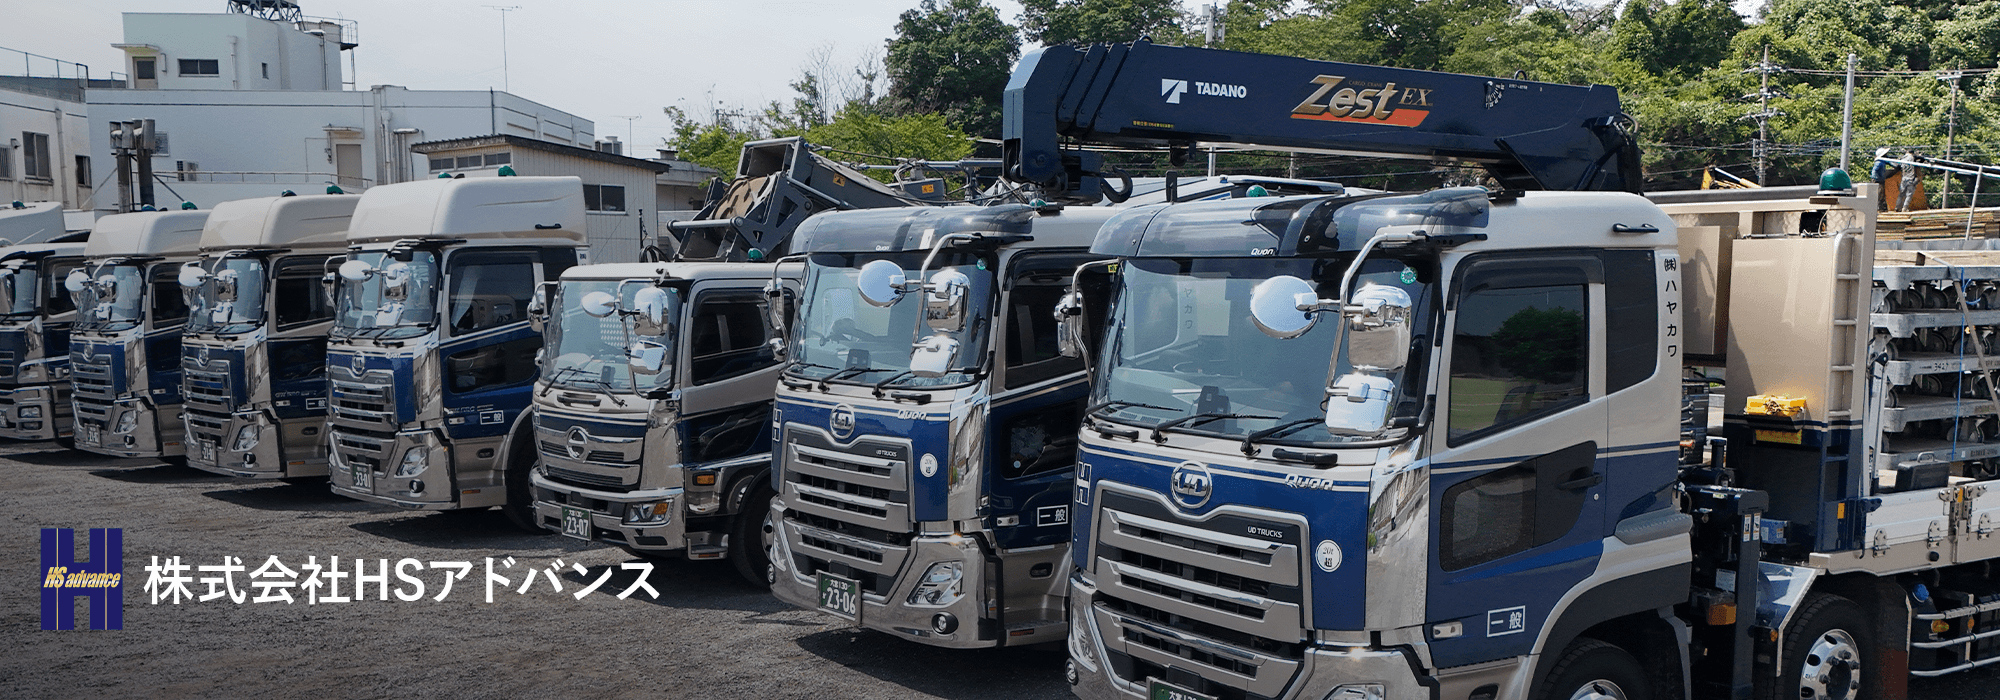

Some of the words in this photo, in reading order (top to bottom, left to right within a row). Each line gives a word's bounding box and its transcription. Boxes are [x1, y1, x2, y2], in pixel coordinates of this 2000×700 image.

[1195, 81, 1247, 98] TADANO
[1291, 74, 1398, 120] Zest
[1398, 87, 1433, 106] EX
[1250, 247, 1274, 256] Quon
[897, 409, 927, 420] Quon
[1174, 472, 1209, 497] UD
[1284, 473, 1334, 490] Quon
[1040, 509, 1065, 521] 一般
[566, 516, 588, 537] 23-07
[1247, 526, 1256, 534] UD
[1257, 527, 1283, 538] TRUCKS
[826, 586, 856, 614] 23-06
[1490, 612, 1522, 629] 一般
